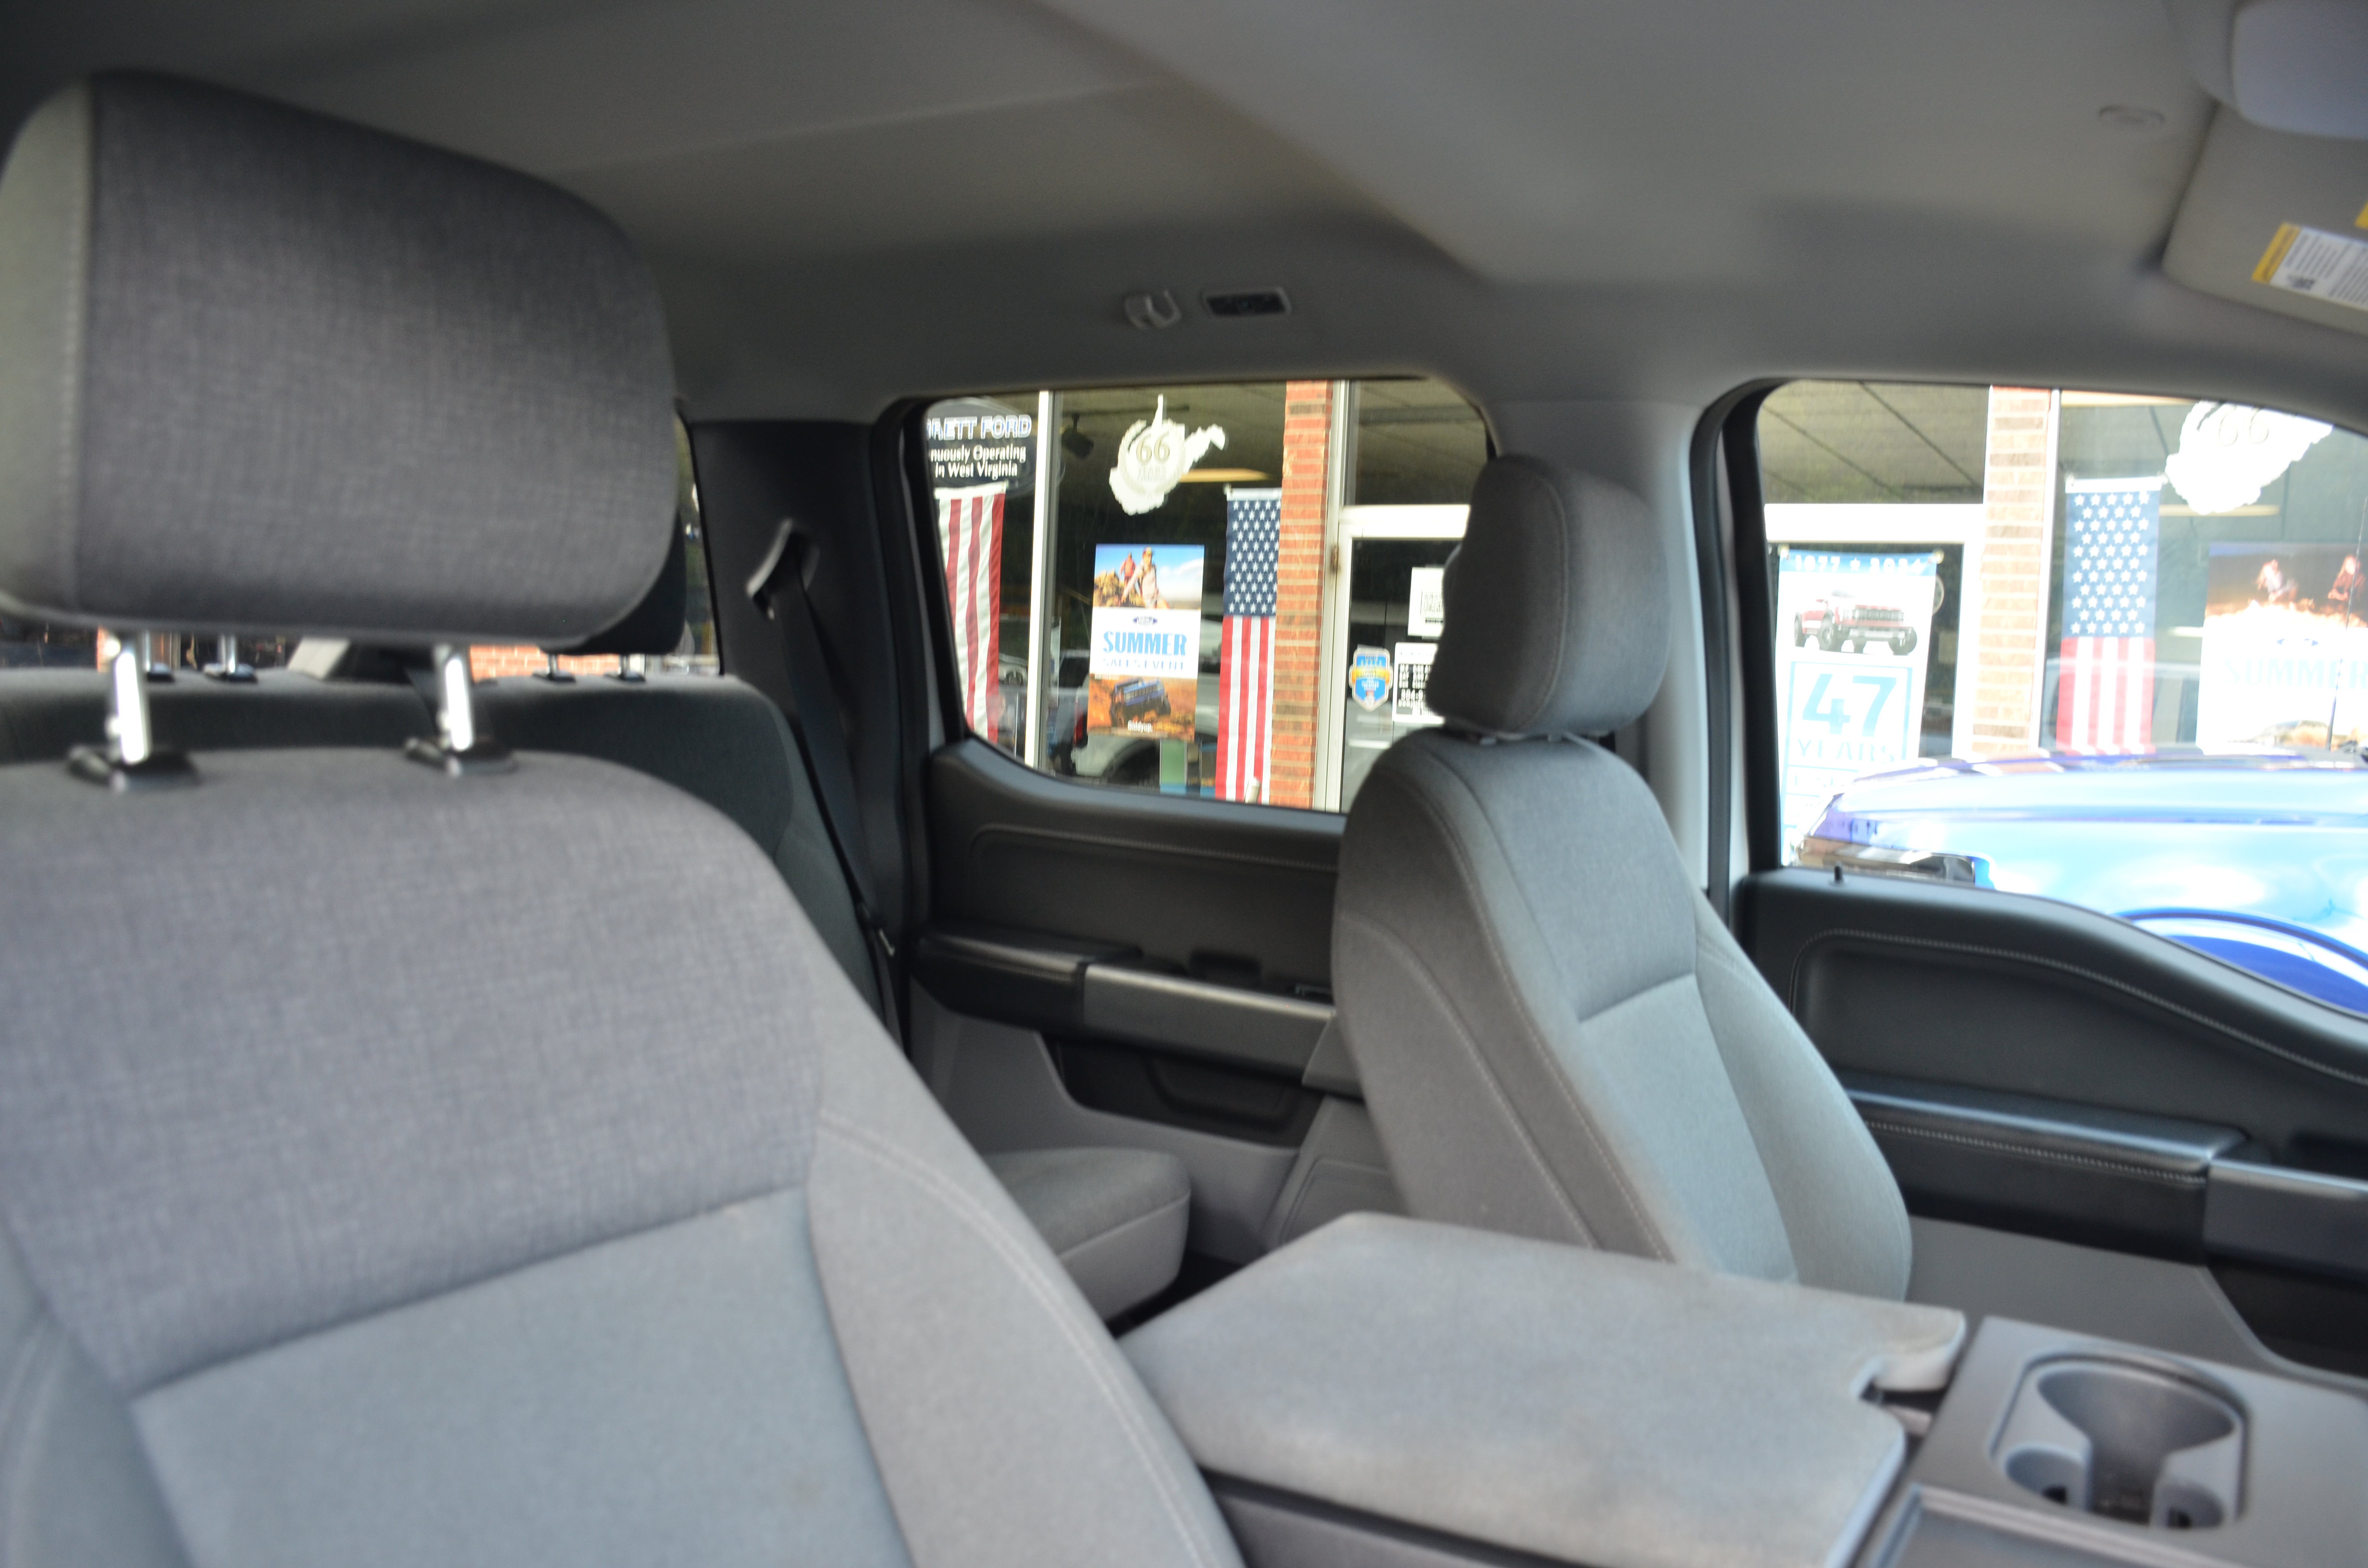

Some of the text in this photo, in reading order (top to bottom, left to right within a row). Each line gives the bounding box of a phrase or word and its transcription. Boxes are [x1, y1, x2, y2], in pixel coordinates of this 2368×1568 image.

[981, 415, 1032, 439] FORD
[973, 443, 1026, 463] Operating
[1136, 431, 1170, 466] 66
[948, 462, 974, 478] West
[977, 461, 1018, 480] Virginia
[1103, 631, 1187, 656] SUMMER
[1802, 674, 1897, 737] 47
[1798, 738, 1896, 764] YEARS
